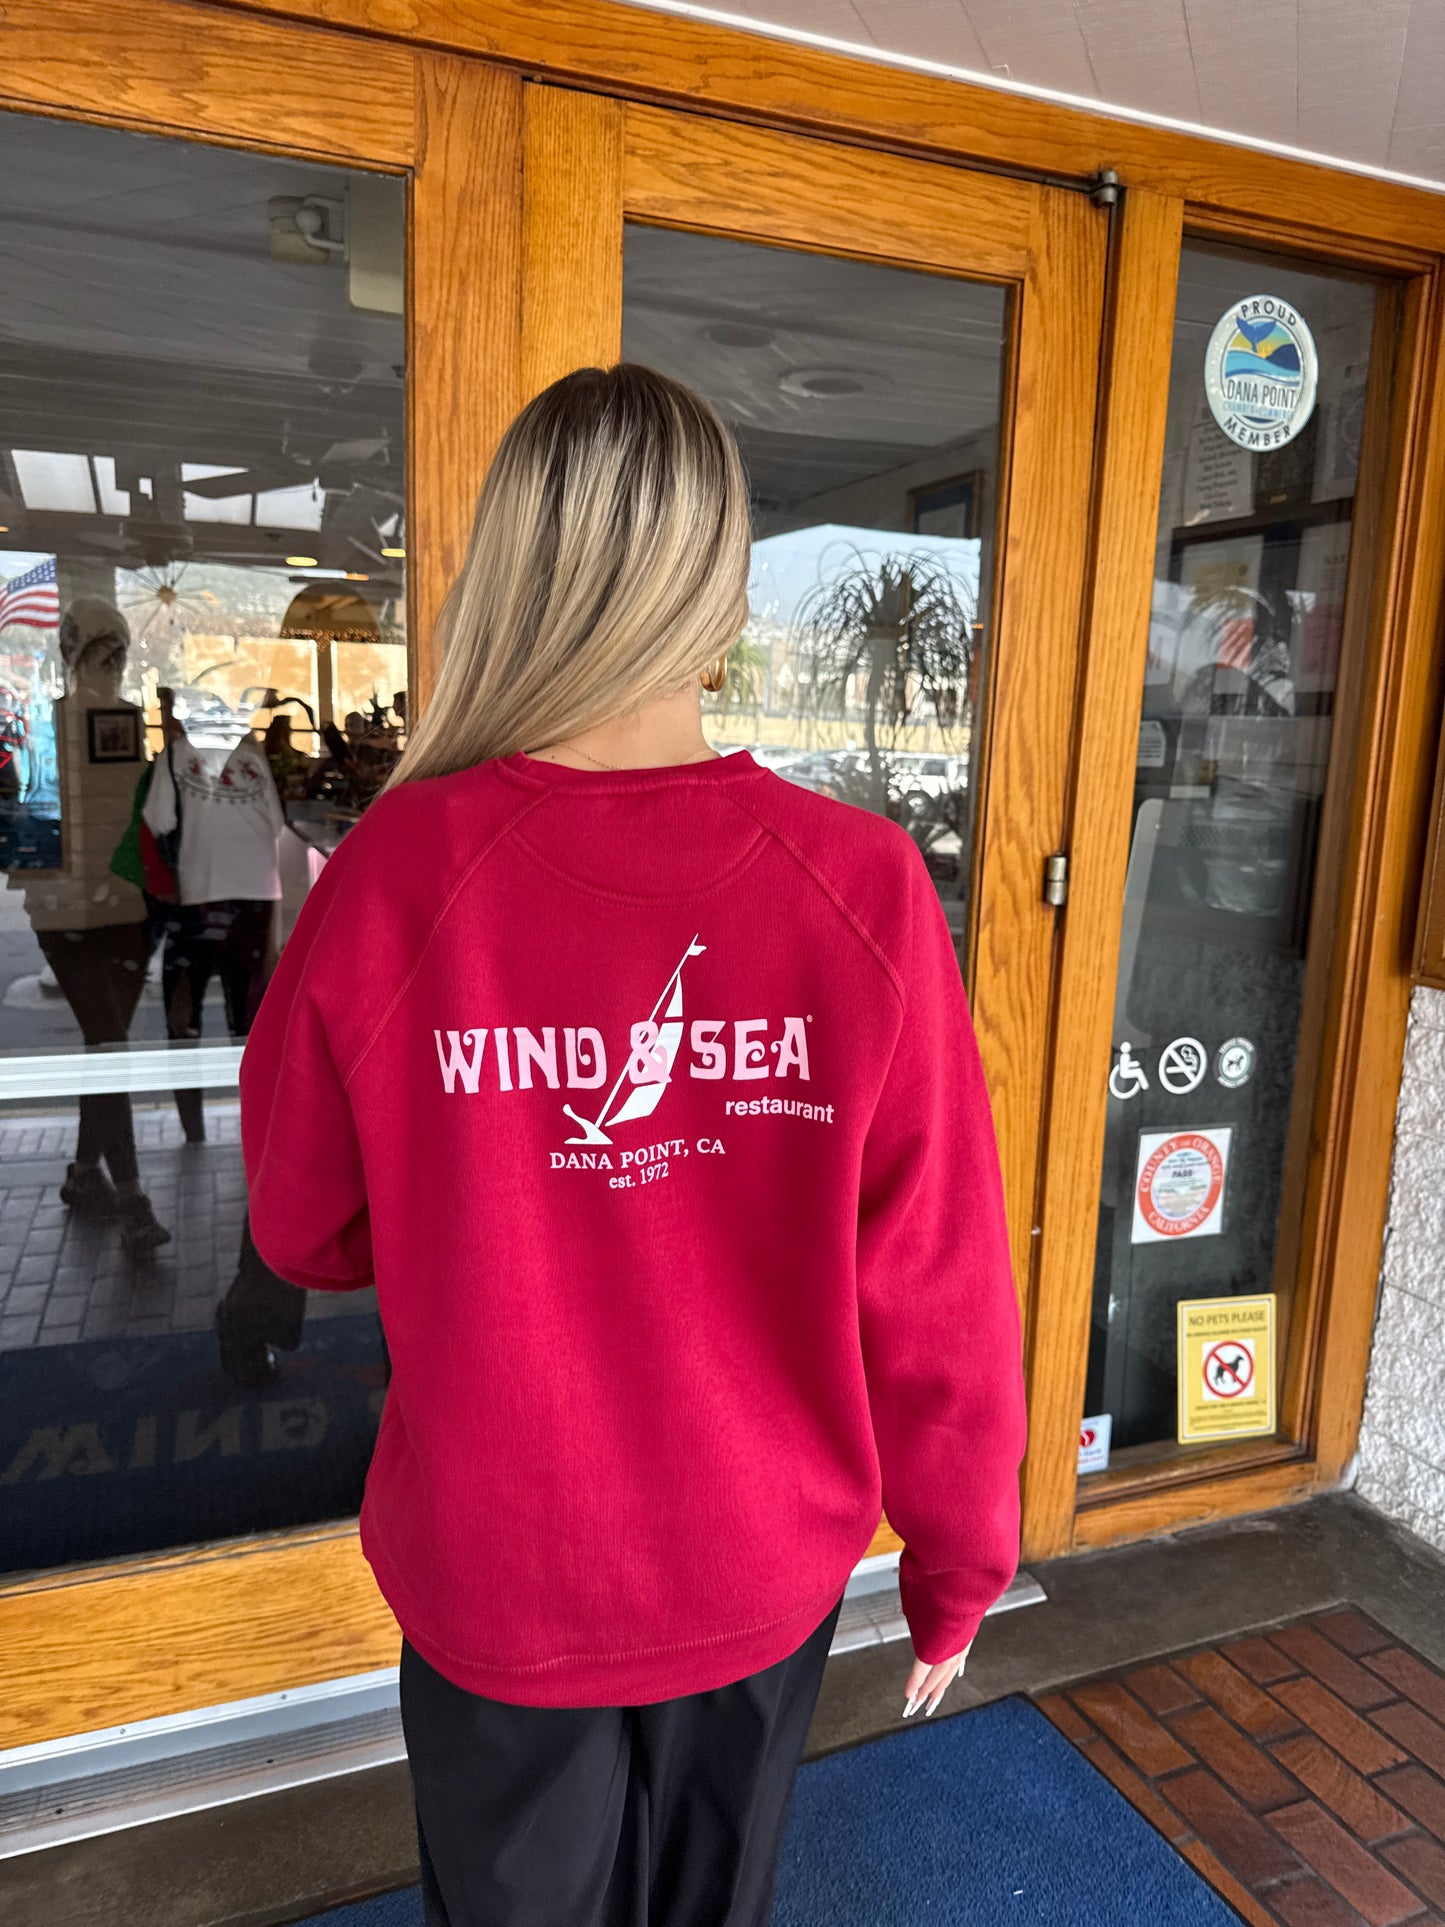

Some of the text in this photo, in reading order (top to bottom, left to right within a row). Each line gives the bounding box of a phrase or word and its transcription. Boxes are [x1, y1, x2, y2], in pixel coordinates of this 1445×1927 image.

[1240, 300, 1297, 327] PROUD
[1227, 379, 1297, 409] DANA POINT
[1223, 416, 1291, 447] MEMBER
[434, 1027, 607, 1094] WIND
[627, 1020, 672, 1084] &
[725, 1096, 835, 1124] restaurant
[549, 1138, 726, 1170] DANA POINT, CA
[1140, 1138, 1178, 1193] COUNTY
[608, 1161, 669, 1189] est. 1972
[1148, 1205, 1211, 1233] CALIFORNIA
[1188, 1310, 1266, 1328] NO PETS PLEASE
